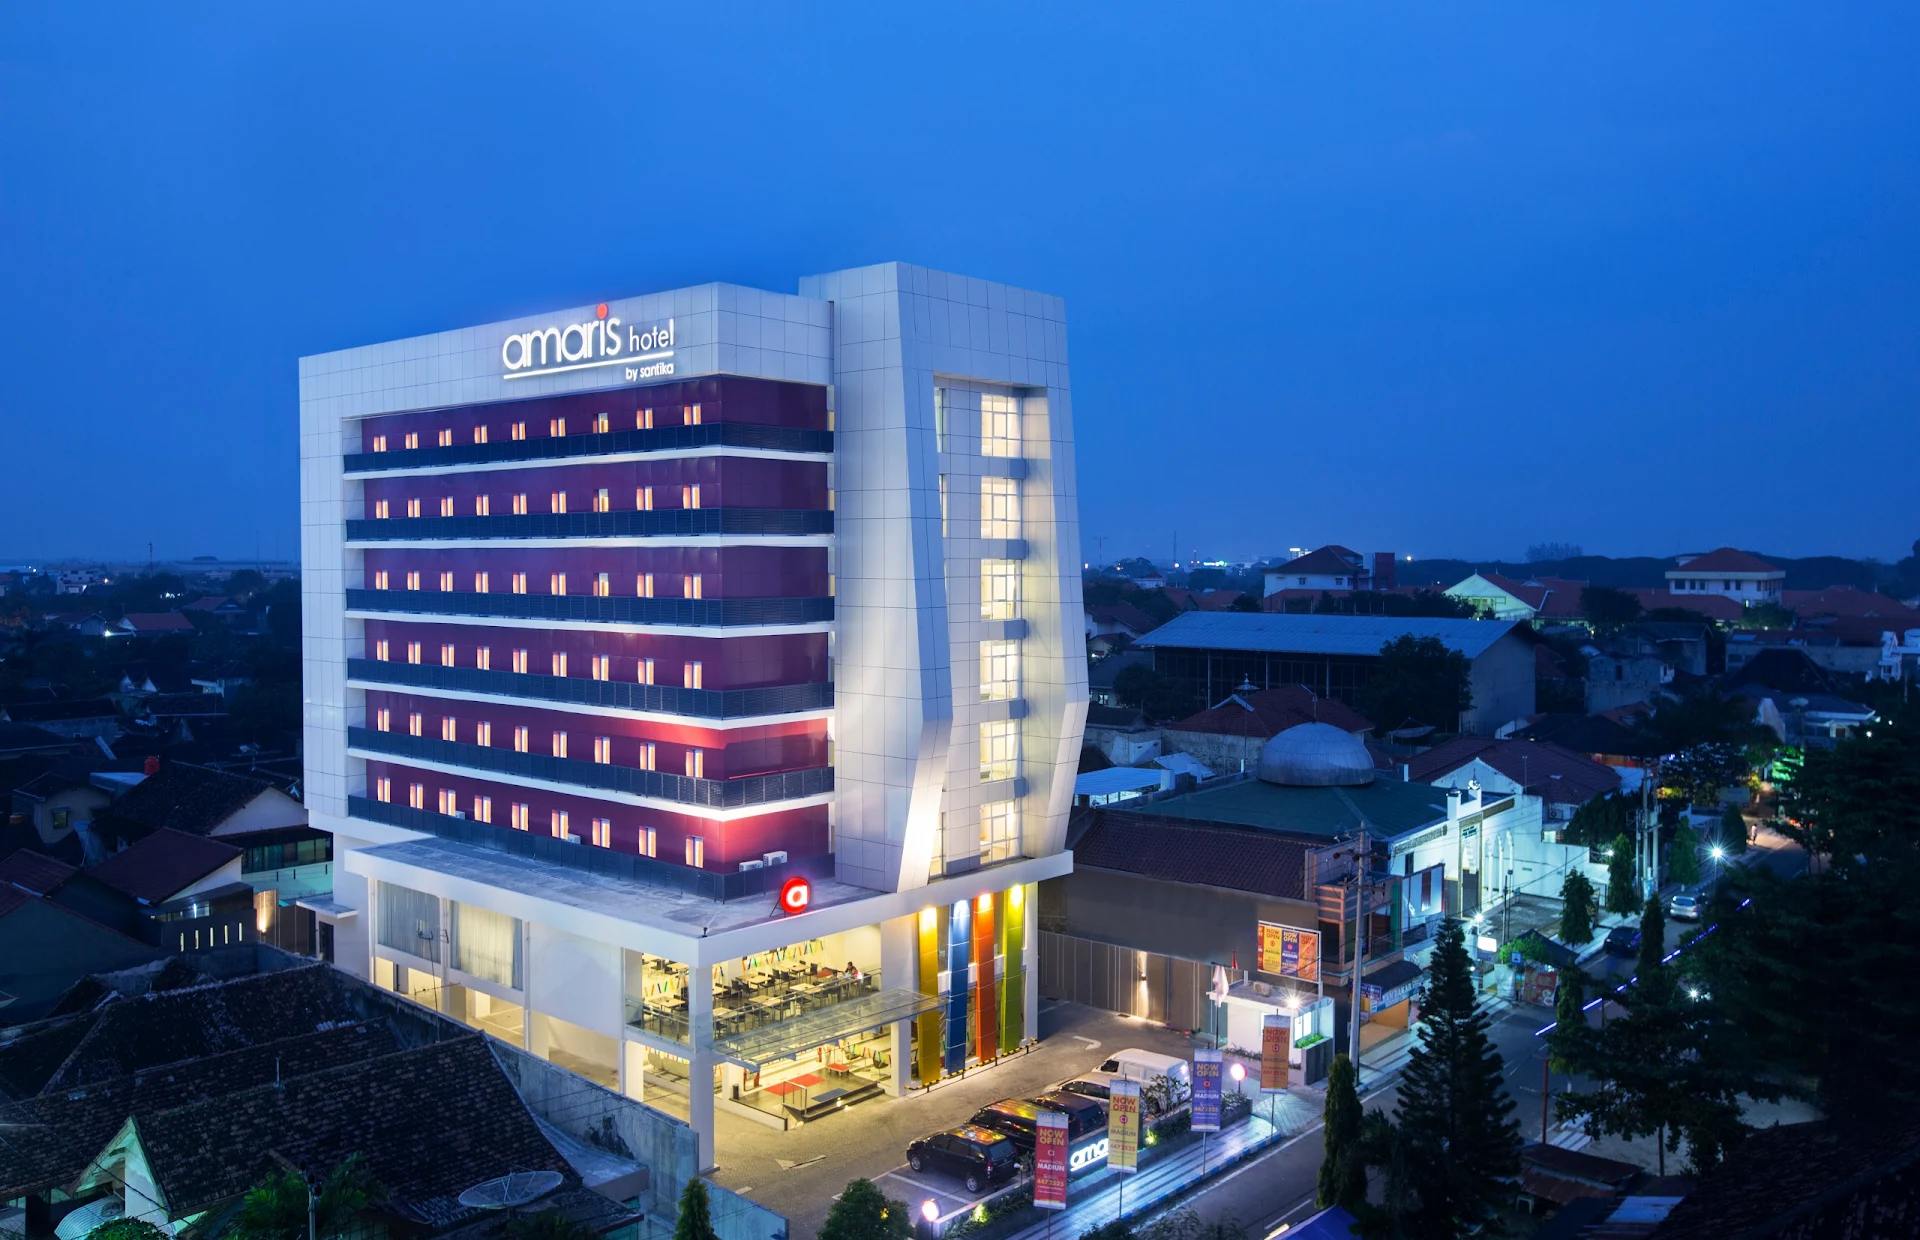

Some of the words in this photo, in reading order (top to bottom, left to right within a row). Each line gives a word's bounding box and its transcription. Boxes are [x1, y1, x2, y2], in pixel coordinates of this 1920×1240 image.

[503, 303, 621, 370] amaris
[629, 318, 674, 352] hotel
[626, 367, 639, 381] by
[639, 362, 674, 378] santika
[786, 885, 807, 907] a
[1266, 1035, 1286, 1043] OPEN
[1197, 1063, 1218, 1071] NOW
[1113, 1096, 1136, 1105] NOW
[1113, 1104, 1136, 1112] OPEN
[1039, 1129, 1064, 1139] NOW
[1040, 1137, 1064, 1146] OPEN
[1037, 1163, 1065, 1171] MADIUN
